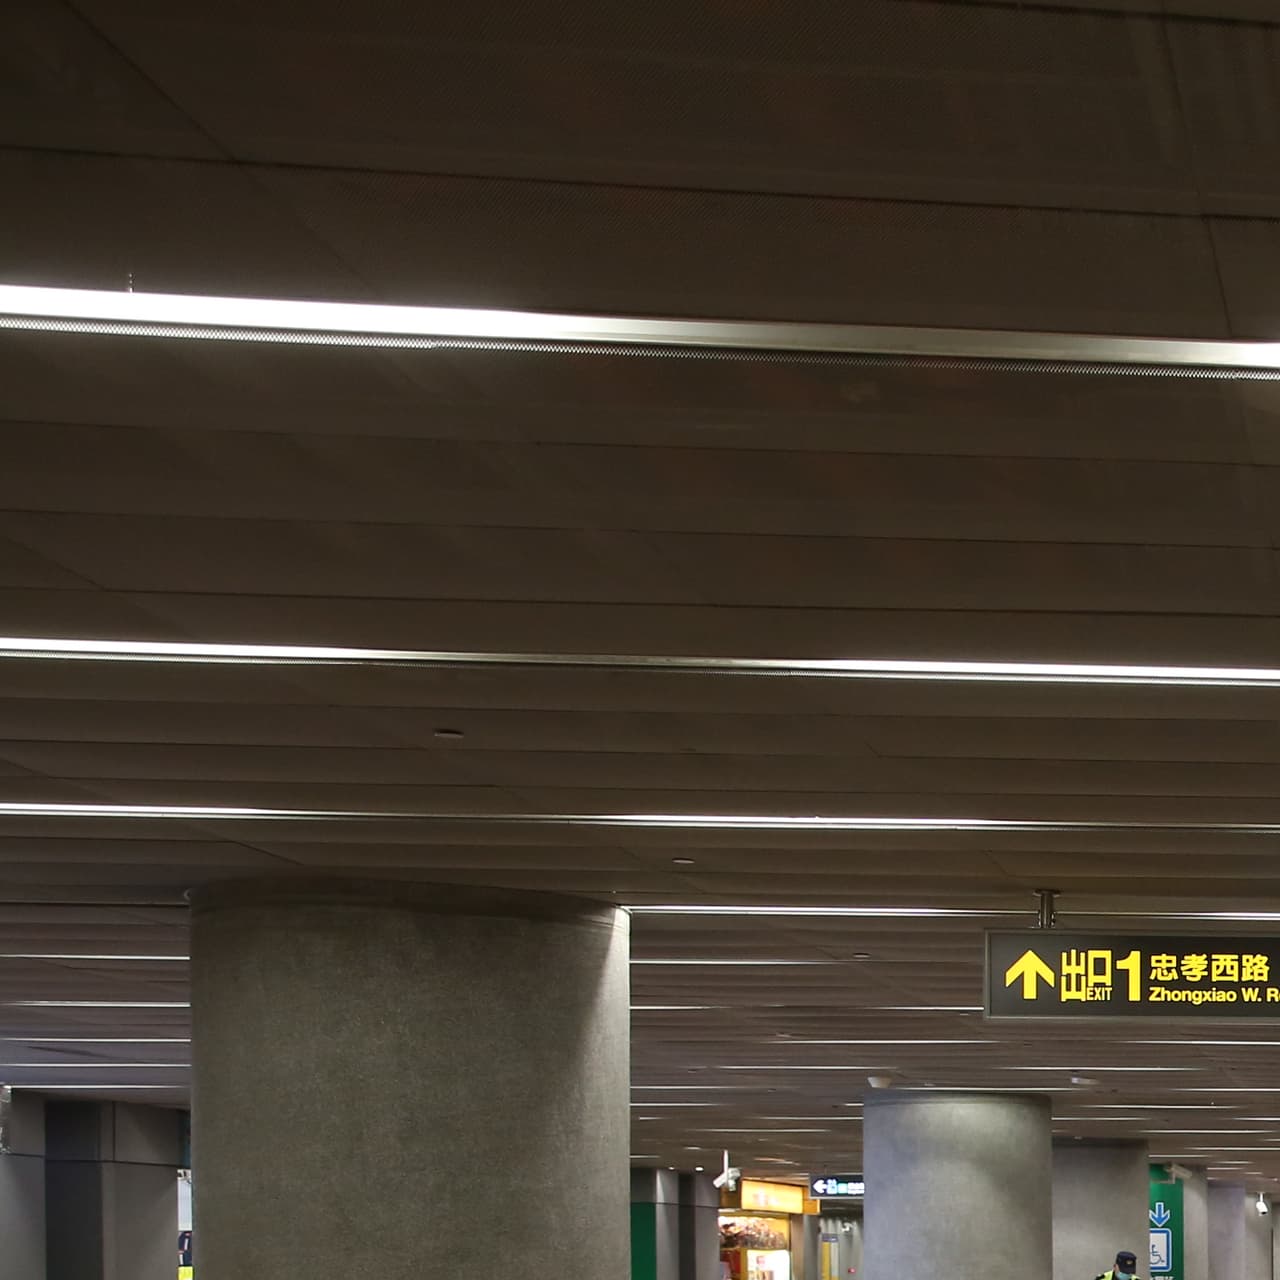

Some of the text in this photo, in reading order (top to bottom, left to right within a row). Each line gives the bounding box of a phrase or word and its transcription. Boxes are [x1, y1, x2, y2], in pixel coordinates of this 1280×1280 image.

[1148, 952, 1271, 984] 忠孝西路
[1087, 986, 1113, 1001] EXIT
[1148, 986, 1237, 1006] Zhongxiao
[1241, 987, 1262, 1003] W.
